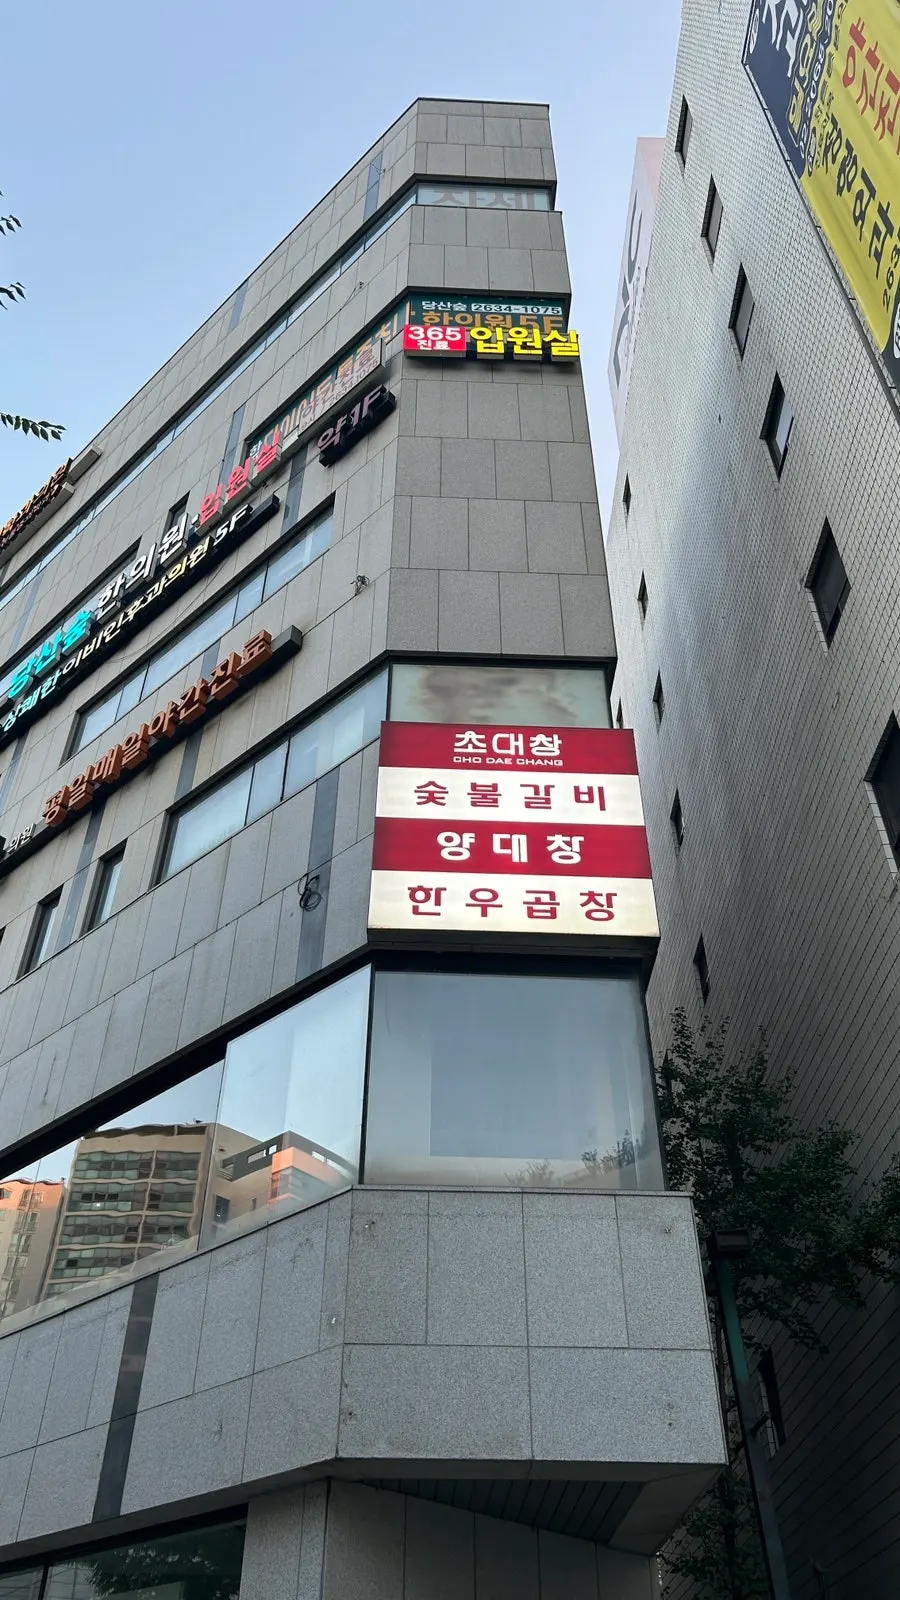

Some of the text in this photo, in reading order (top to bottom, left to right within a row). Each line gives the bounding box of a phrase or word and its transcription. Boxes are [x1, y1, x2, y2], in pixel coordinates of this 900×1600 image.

[822, 112, 895, 280] 정형외과
[421, 300, 560, 315] 당산숲 2634-1075
[408, 326, 462, 342] 365
[519, 314, 563, 334] 5F
[416, 340, 451, 351] 진료
[470, 326, 580, 357] 입원실
[213, 504, 249, 546] 5F
[9, 610, 92, 698] 당산숲
[453, 731, 563, 757] 초대창
[453, 756, 564, 767] CHO DAE CHANG
